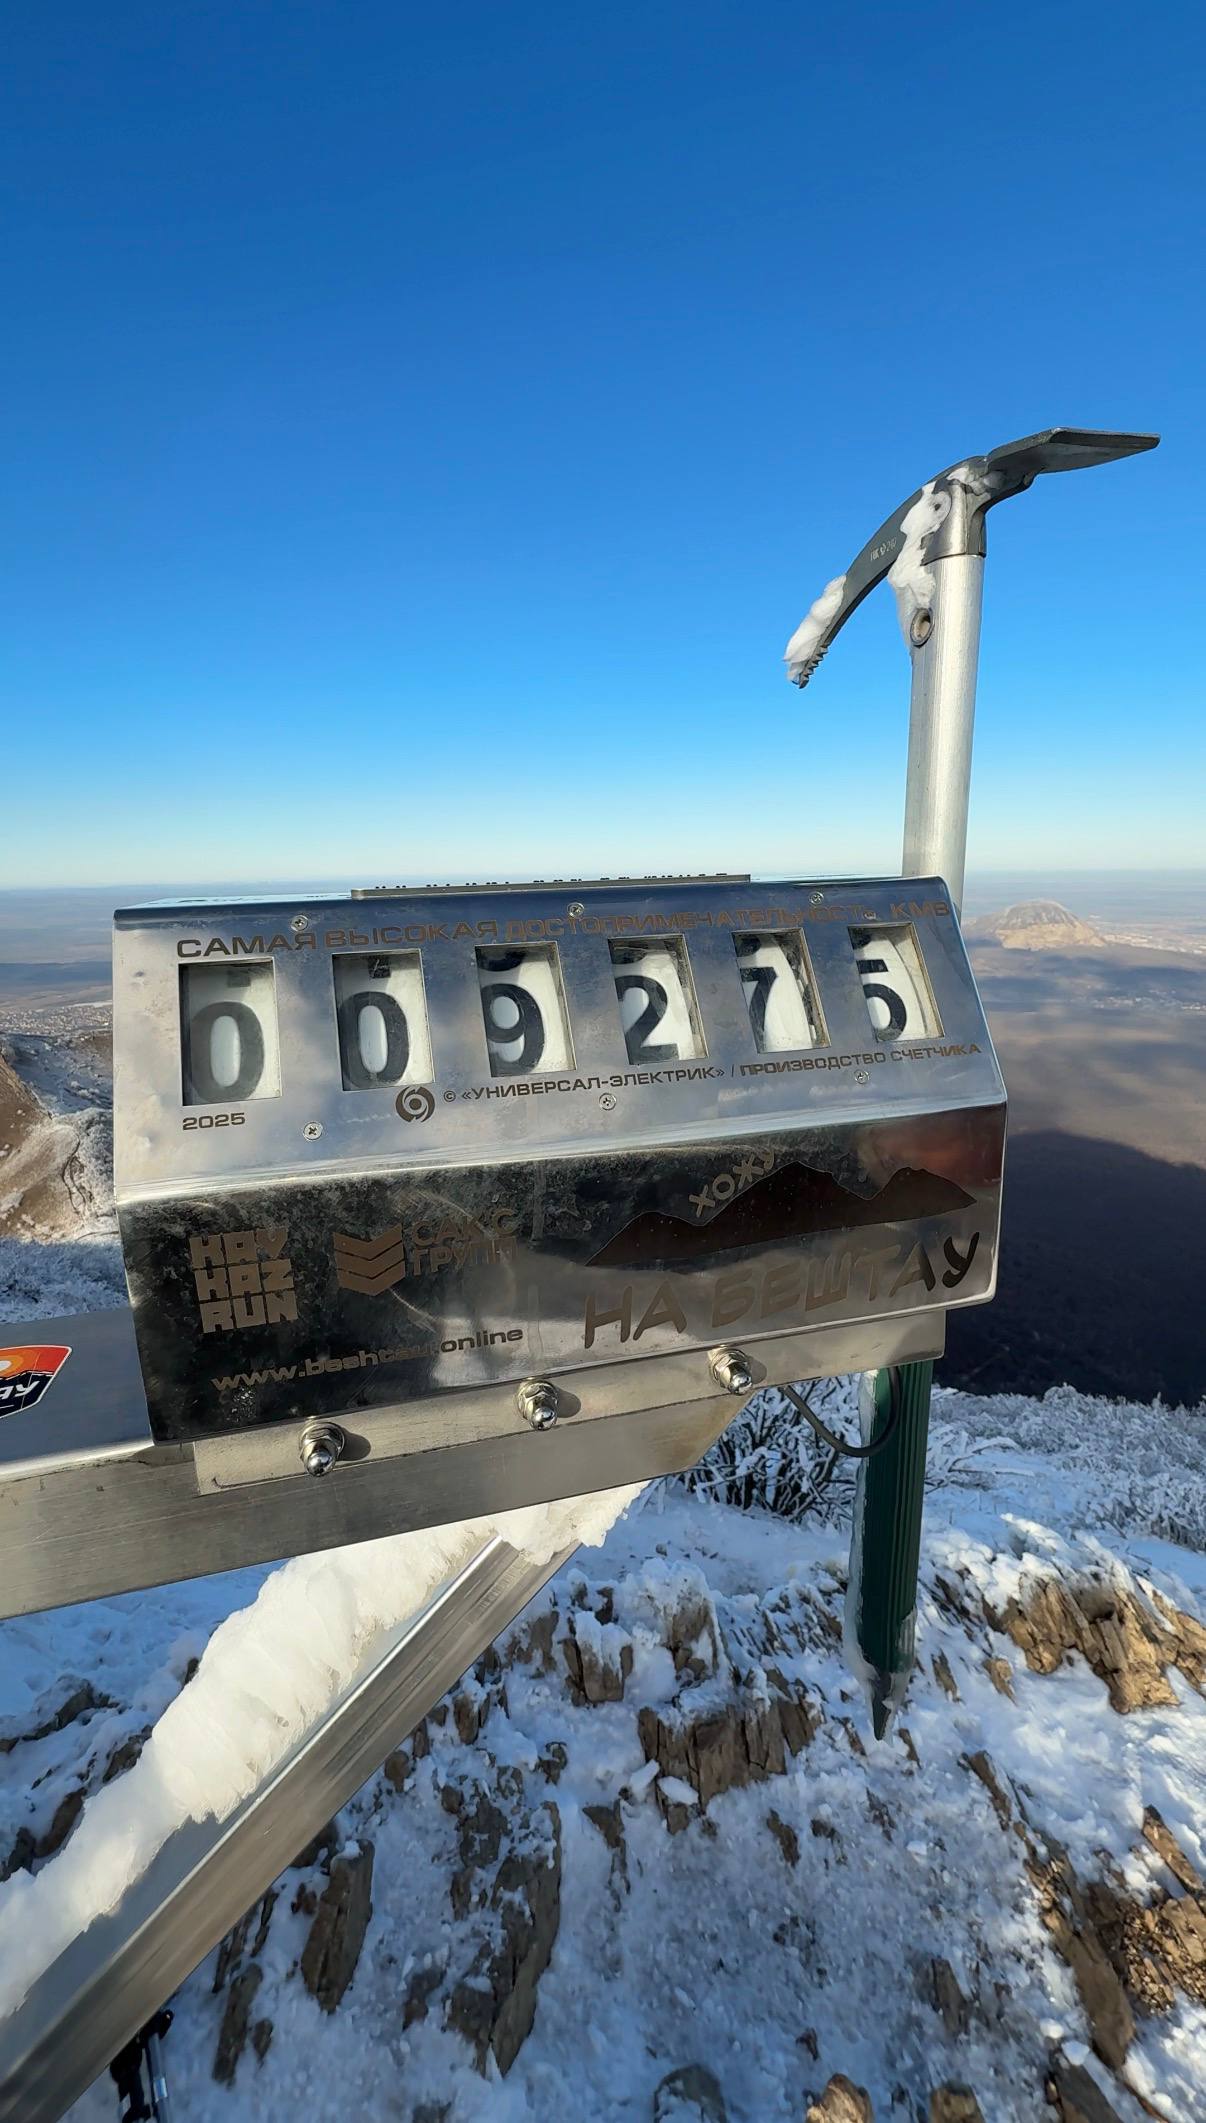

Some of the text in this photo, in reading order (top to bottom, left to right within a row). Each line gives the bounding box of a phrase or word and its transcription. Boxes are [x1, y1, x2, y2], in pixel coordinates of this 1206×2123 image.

[177, 932, 317, 958] САМАЯ
[325, 920, 498, 949] ВЫСОКАЯ
[889, 902, 950, 920] КМВ
[462, 1066, 725, 1102] «УНИВЕРСАЛ-ЭЛЕКТРИК»
[740, 1051, 886, 1077] ПРОИЗВОДСТВО
[890, 1043, 982, 1063] СЧЕТЧИКА
[182, 1112, 246, 1131] 2025
[688, 1148, 776, 1218] ХОЖУ
[199, 1289, 299, 1335] RUN
[584, 1231, 981, 1350] НА БЕШТАУ
[211, 1328, 524, 1392] www.beshtau.online
